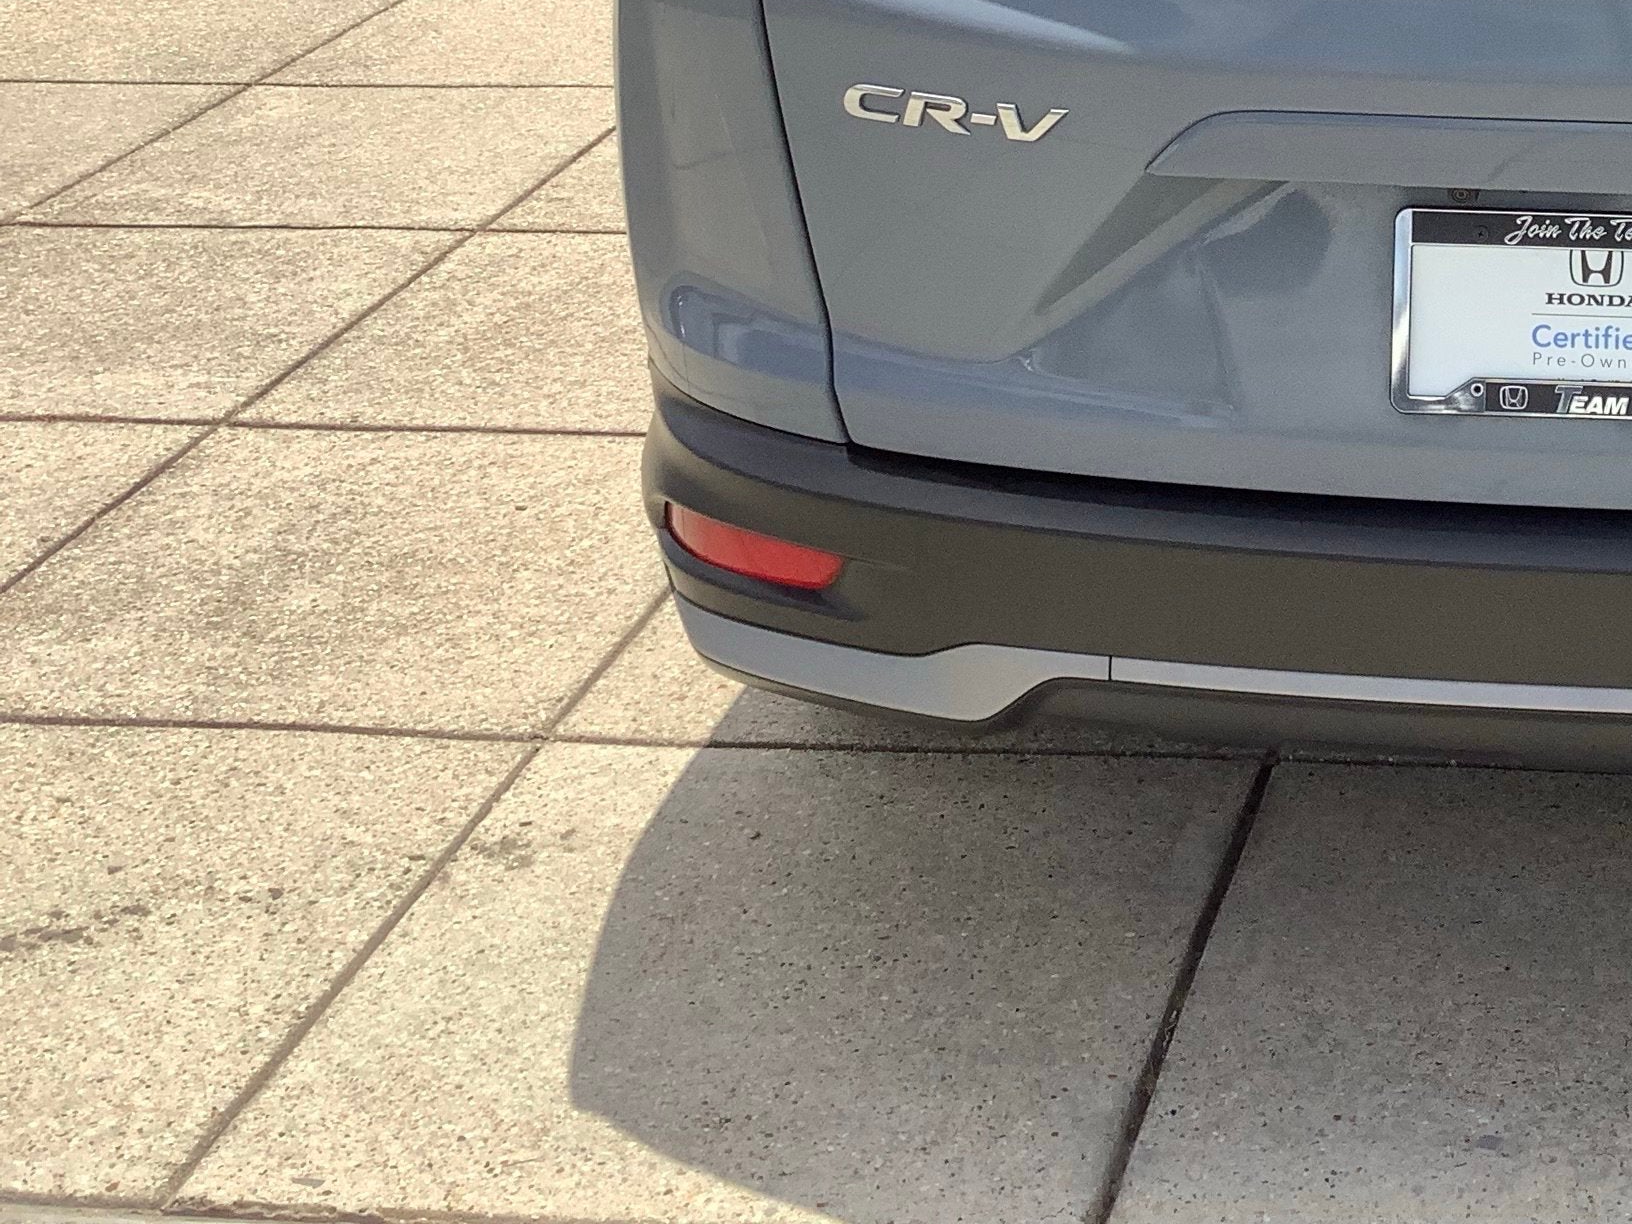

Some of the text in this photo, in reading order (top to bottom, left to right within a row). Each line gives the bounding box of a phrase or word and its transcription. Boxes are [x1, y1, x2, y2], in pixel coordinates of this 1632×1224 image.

[842, 82, 1070, 143] CR-V
[1504, 215, 1562, 245] Join
[1564, 217, 1607, 241] The
[1554, 384, 1630, 416] TEAM
